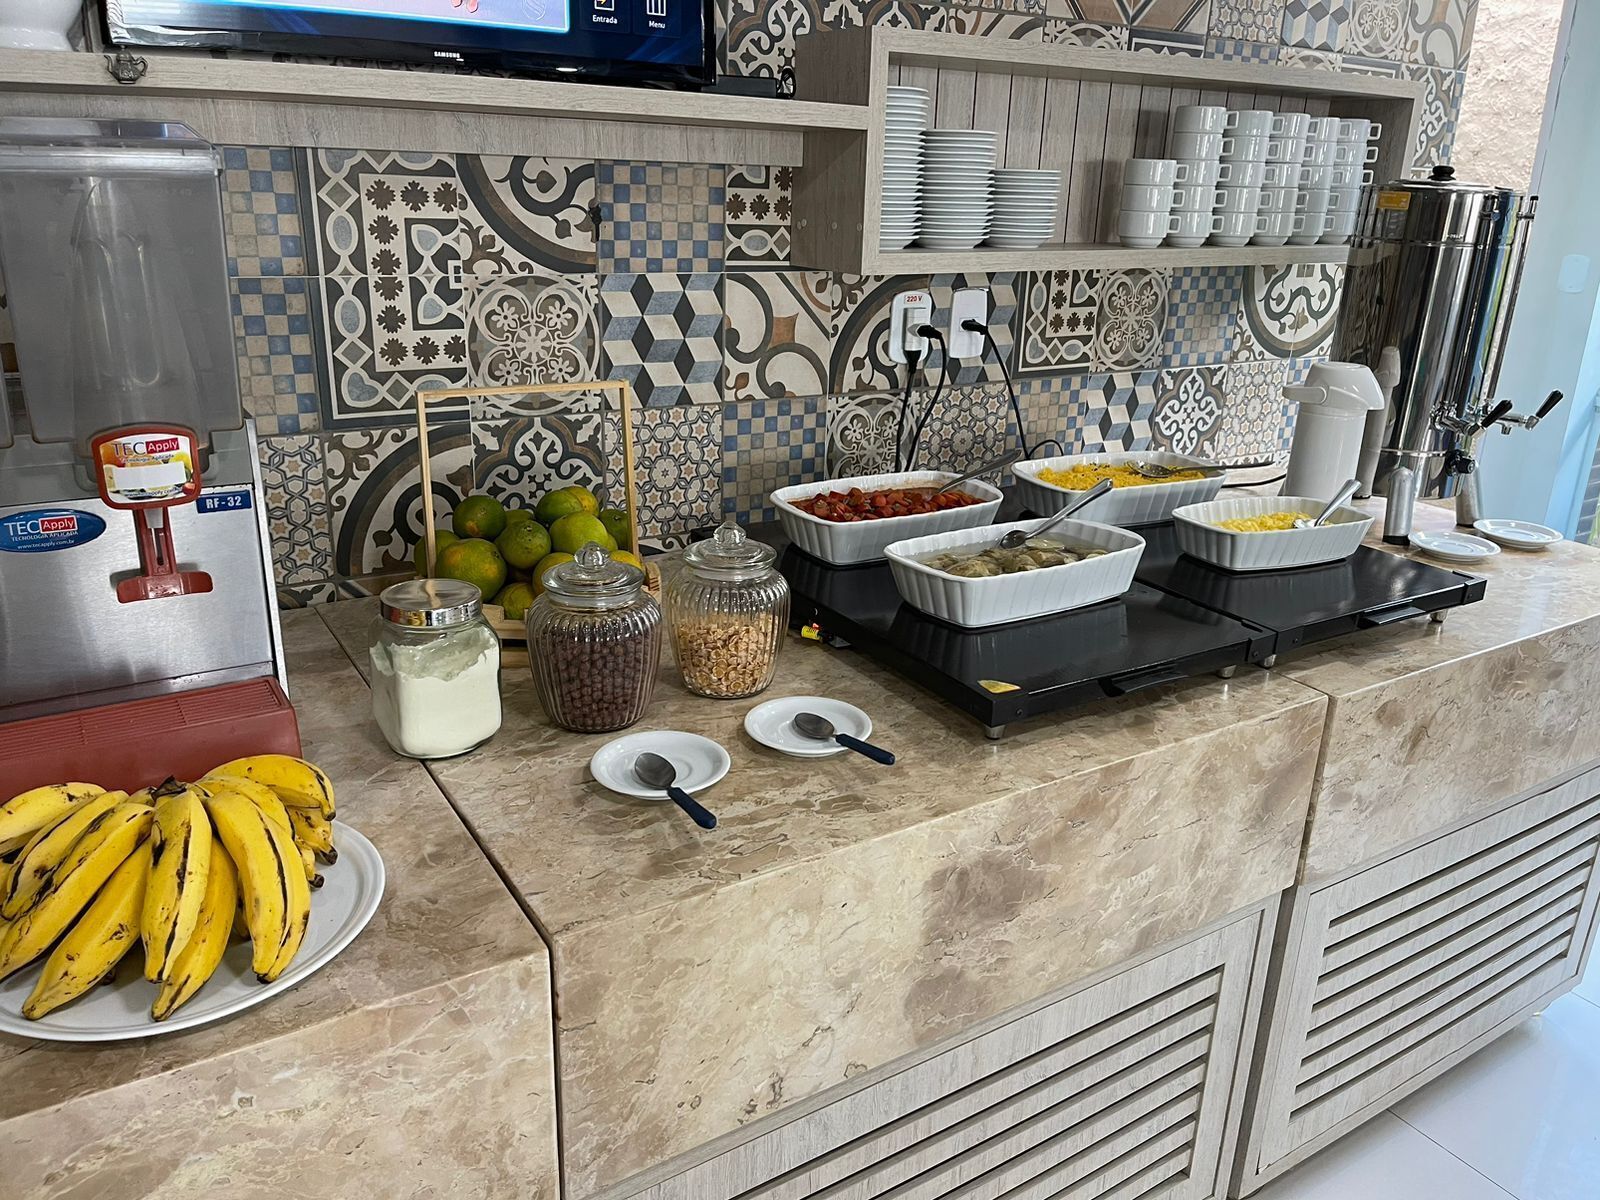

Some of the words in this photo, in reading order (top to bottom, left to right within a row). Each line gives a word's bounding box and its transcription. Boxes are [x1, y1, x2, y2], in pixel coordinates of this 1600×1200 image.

[592, 14, 618, 24] Entrada
[648, 20, 666, 29] Menu
[433, 51, 461, 59] SAMSUNG
[205, 495, 242, 509] RF-32
[17, 538, 75, 550] www.tecapply.com.br
